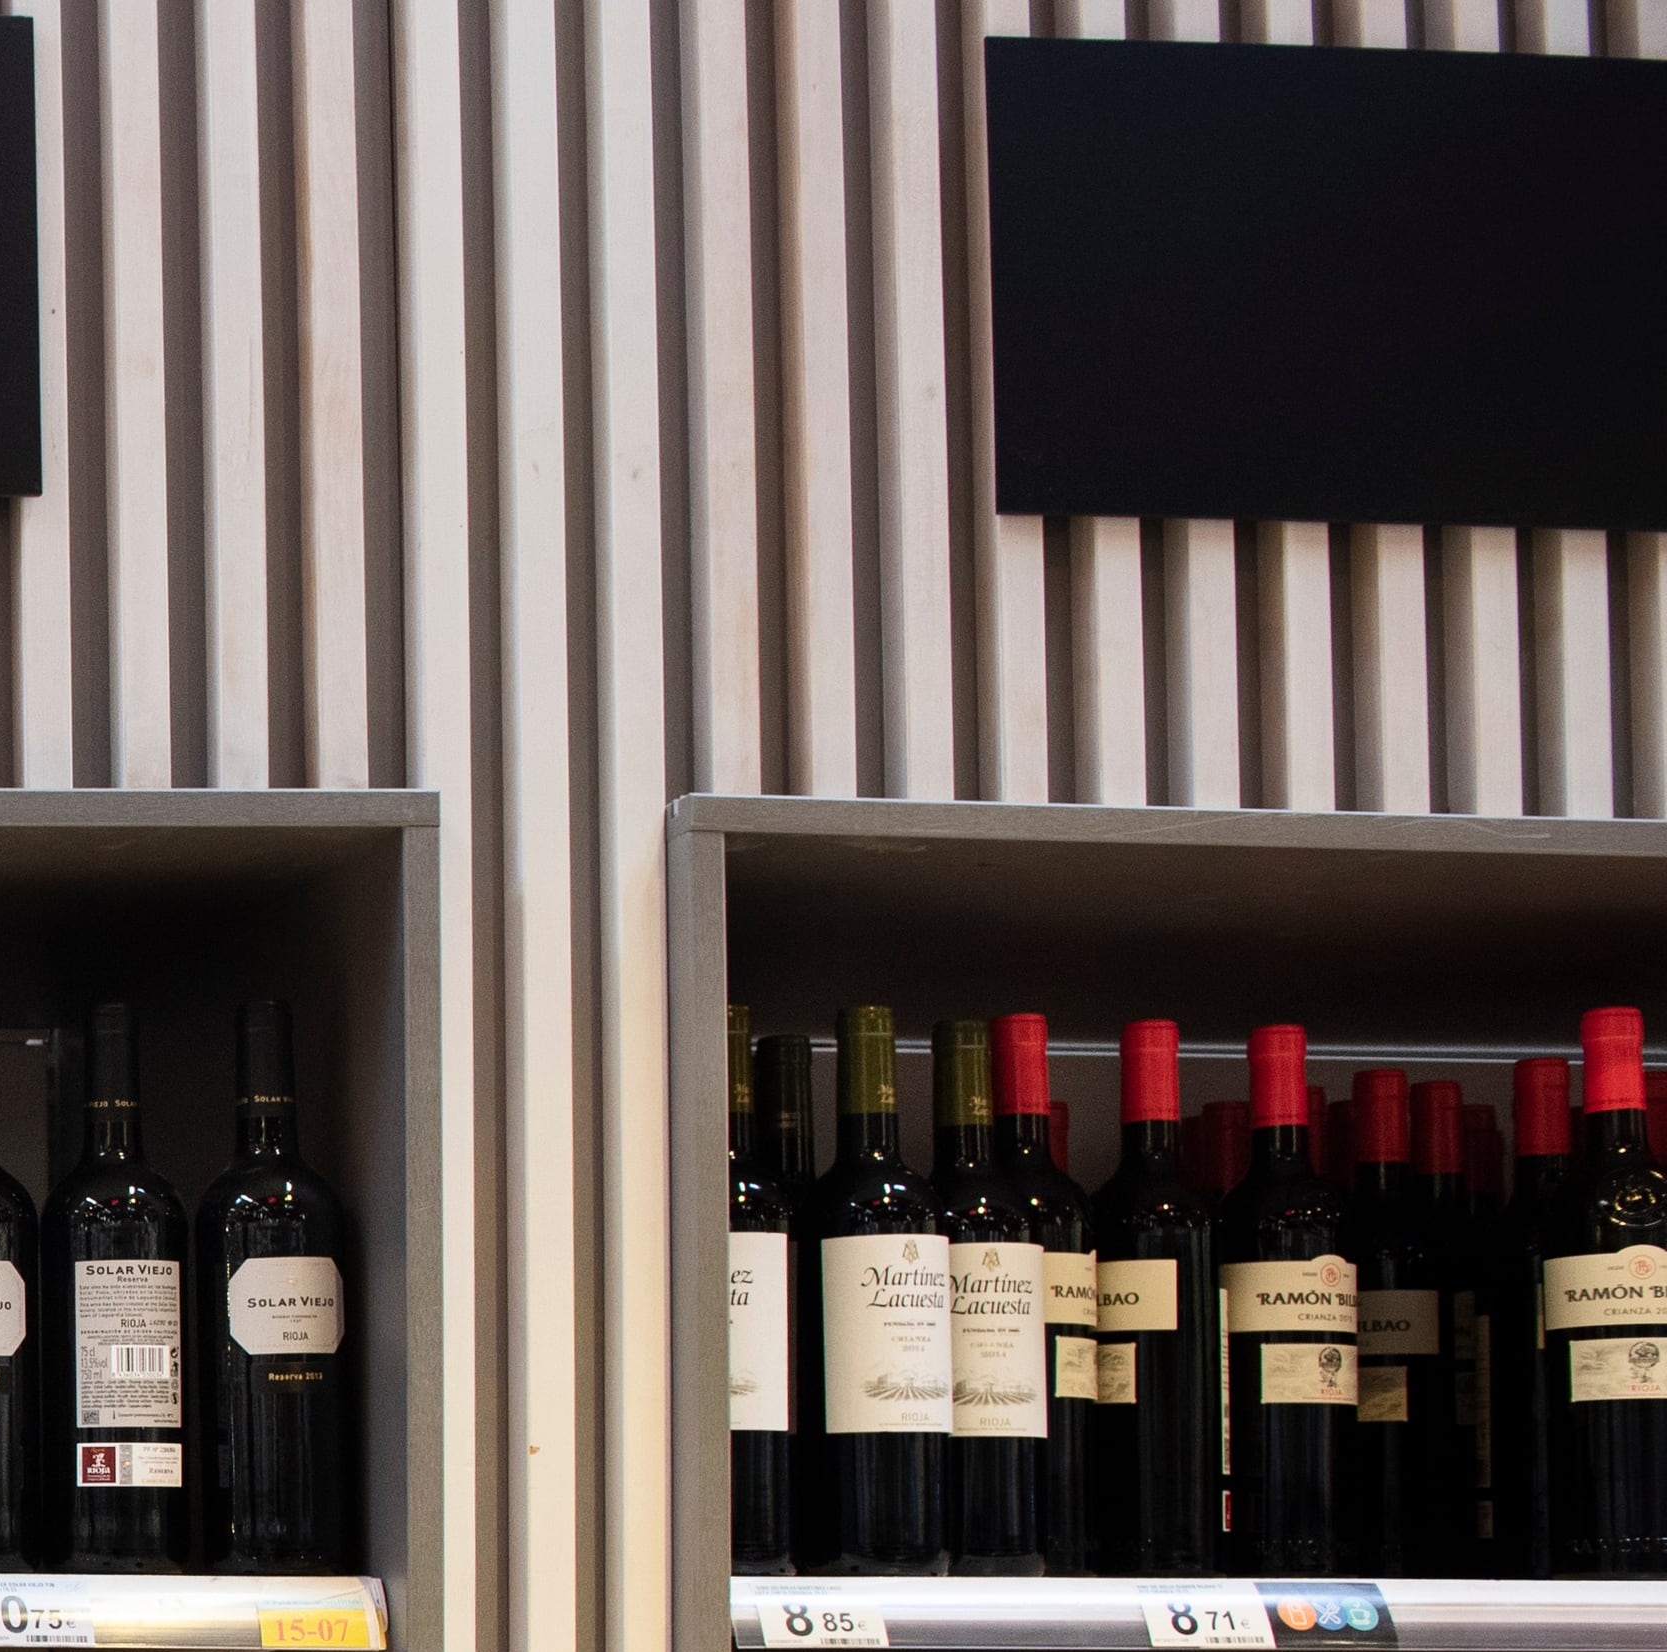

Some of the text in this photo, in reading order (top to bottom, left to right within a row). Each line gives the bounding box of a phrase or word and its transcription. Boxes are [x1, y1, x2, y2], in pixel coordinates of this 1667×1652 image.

[861, 1265, 946, 1289] Martínez
[867, 1288, 945, 1310] Lacuesta
[30, 1608, 64, 1631] 75
[782, 1599, 855, 1637] 8 85
[1167, 1602, 1236, 1636] 8 71
[274, 1618, 350, 1643] 15-07
